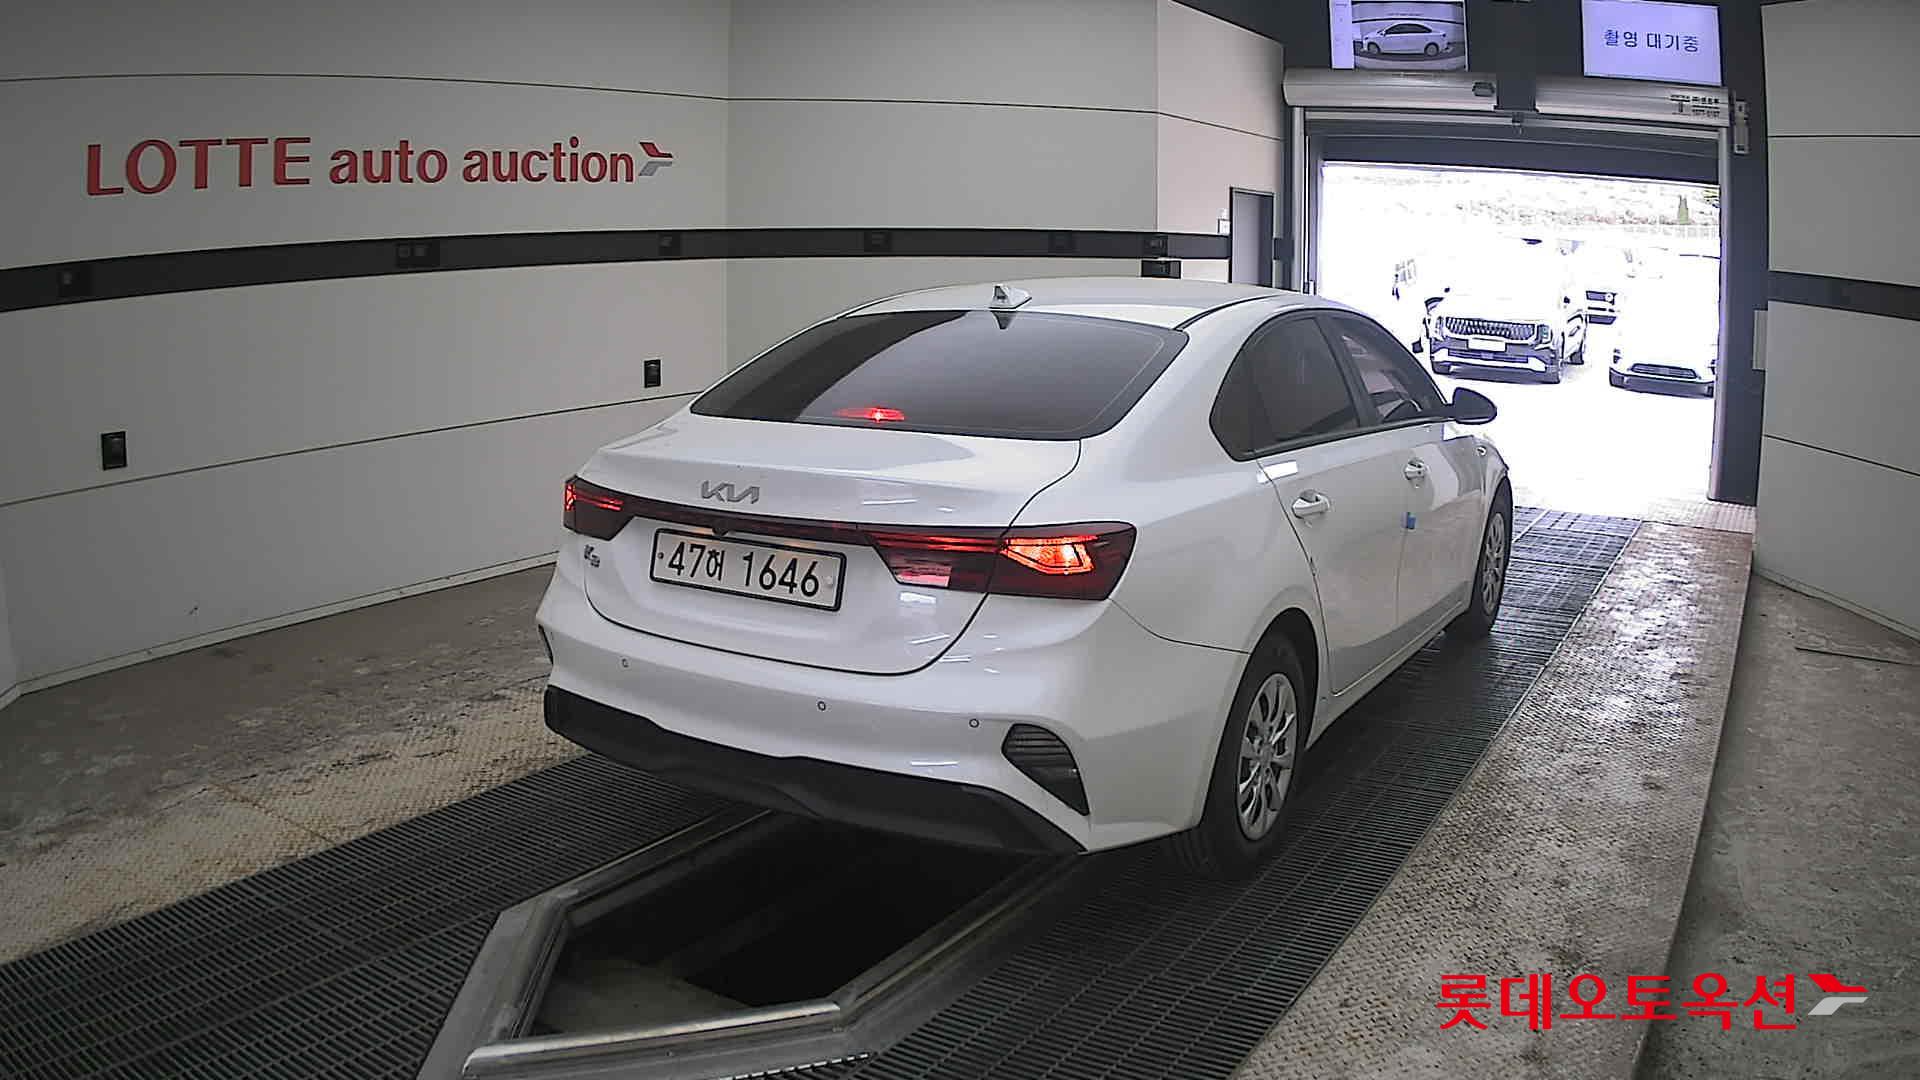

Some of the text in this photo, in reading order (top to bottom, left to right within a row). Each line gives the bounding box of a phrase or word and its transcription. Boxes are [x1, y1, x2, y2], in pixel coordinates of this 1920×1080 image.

[1604, 29, 1700, 53] 촬영 대기중
[86, 136, 634, 196] LOTTE auto auction
[668, 541, 820, 598] 47허 1646
